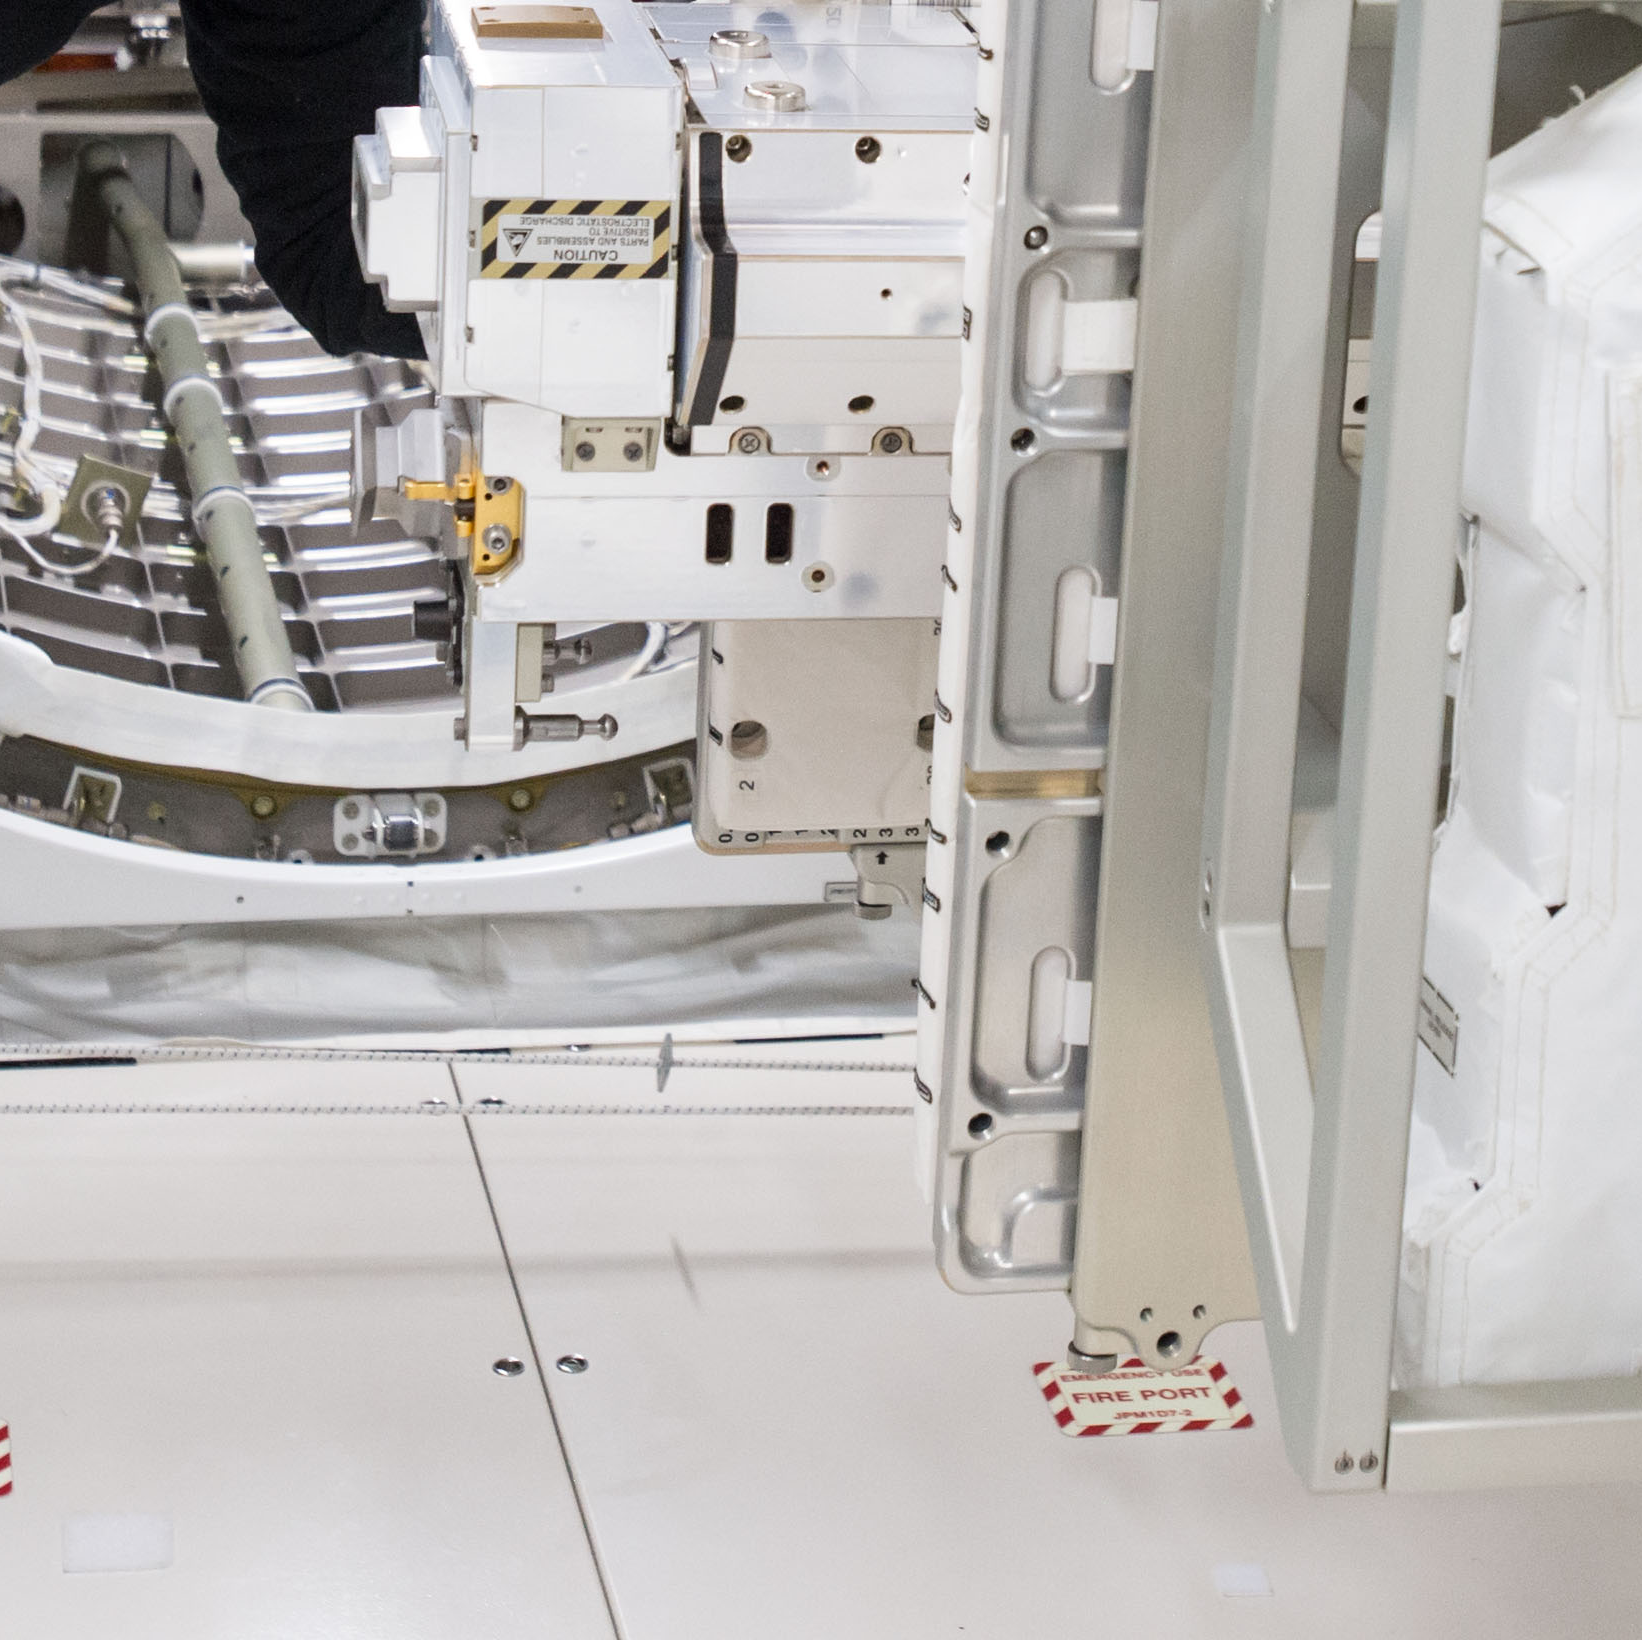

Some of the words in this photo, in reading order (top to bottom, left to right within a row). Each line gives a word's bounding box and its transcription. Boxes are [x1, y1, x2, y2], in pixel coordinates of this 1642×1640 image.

[520, 216, 574, 225] DISCHARGE
[576, 217, 650, 227] ELECTROSTATIC
[589, 227, 601, 236] TO
[603, 227, 649, 236] SENSITIVE
[536, 236, 595, 246] ASSEMBLIES
[598, 236, 617, 246] AND
[619, 237, 649, 247] PARTS
[553, 249, 618, 261] CAUTION
[739, 779, 755, 791] 2
[1060, 1371, 1166, 1383] EMERGENCY
[1172, 1369, 1205, 1377] USE
[1072, 1391, 1134, 1404] FIRE
[1139, 1387, 1210, 1401] PORT
[1113, 1409, 1193, 1420] JPM1D7-2
